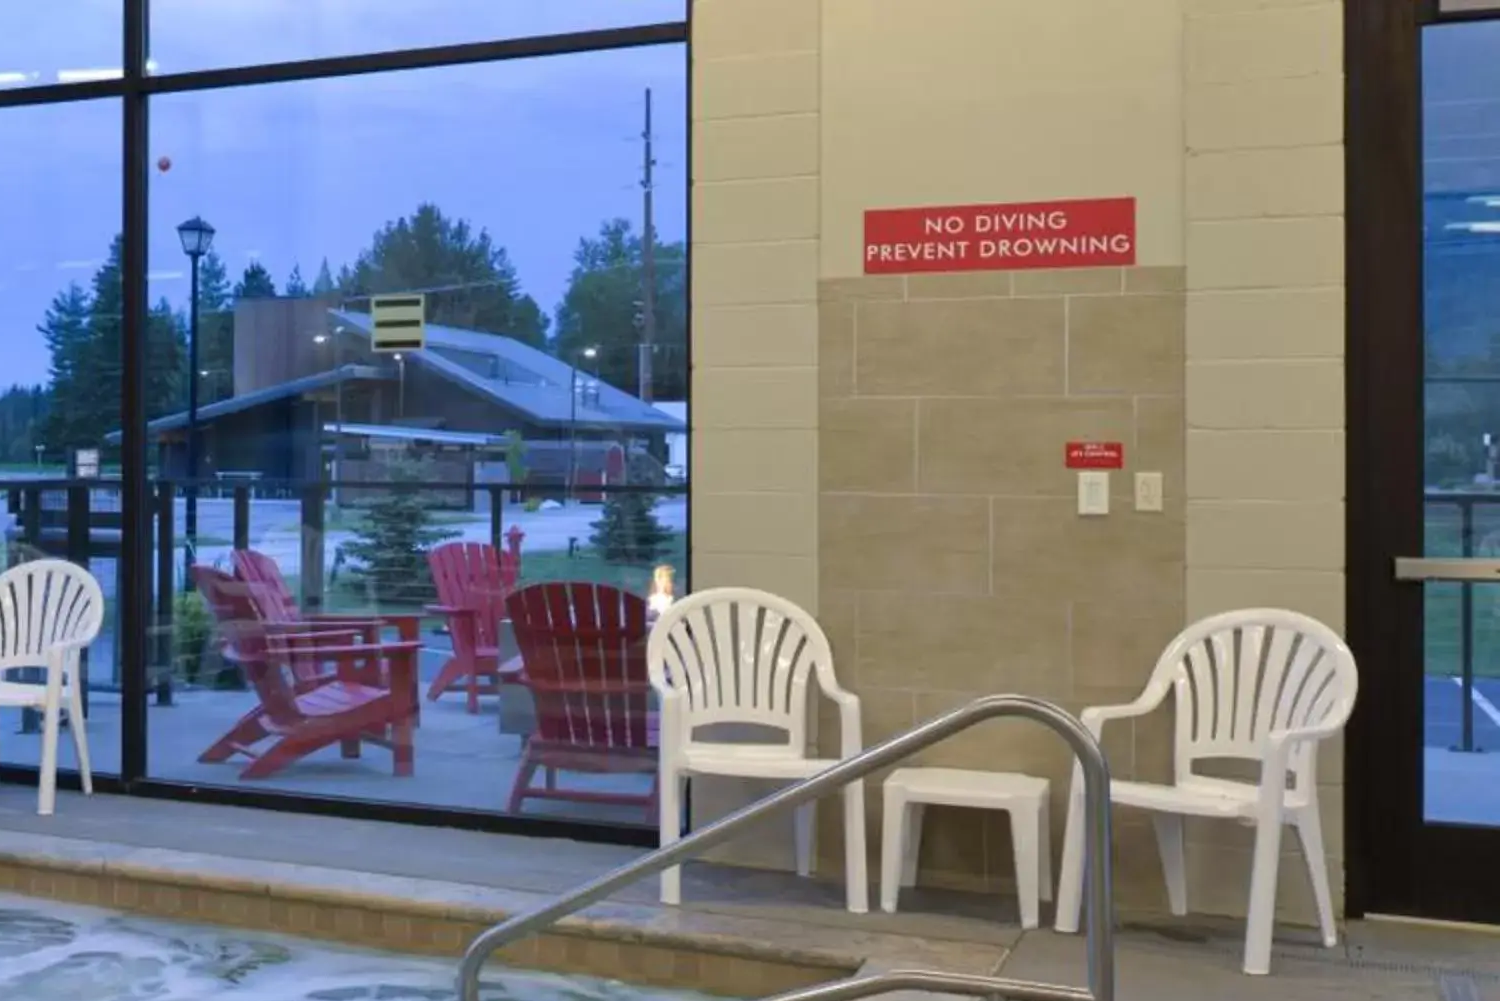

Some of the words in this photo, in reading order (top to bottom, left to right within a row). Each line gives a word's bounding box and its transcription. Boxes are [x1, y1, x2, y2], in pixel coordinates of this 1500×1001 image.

[925, 216, 964, 234] NO
[976, 211, 1067, 232] DIVING
[867, 241, 970, 261] PREVENT
[979, 234, 1130, 258] DROWNING
